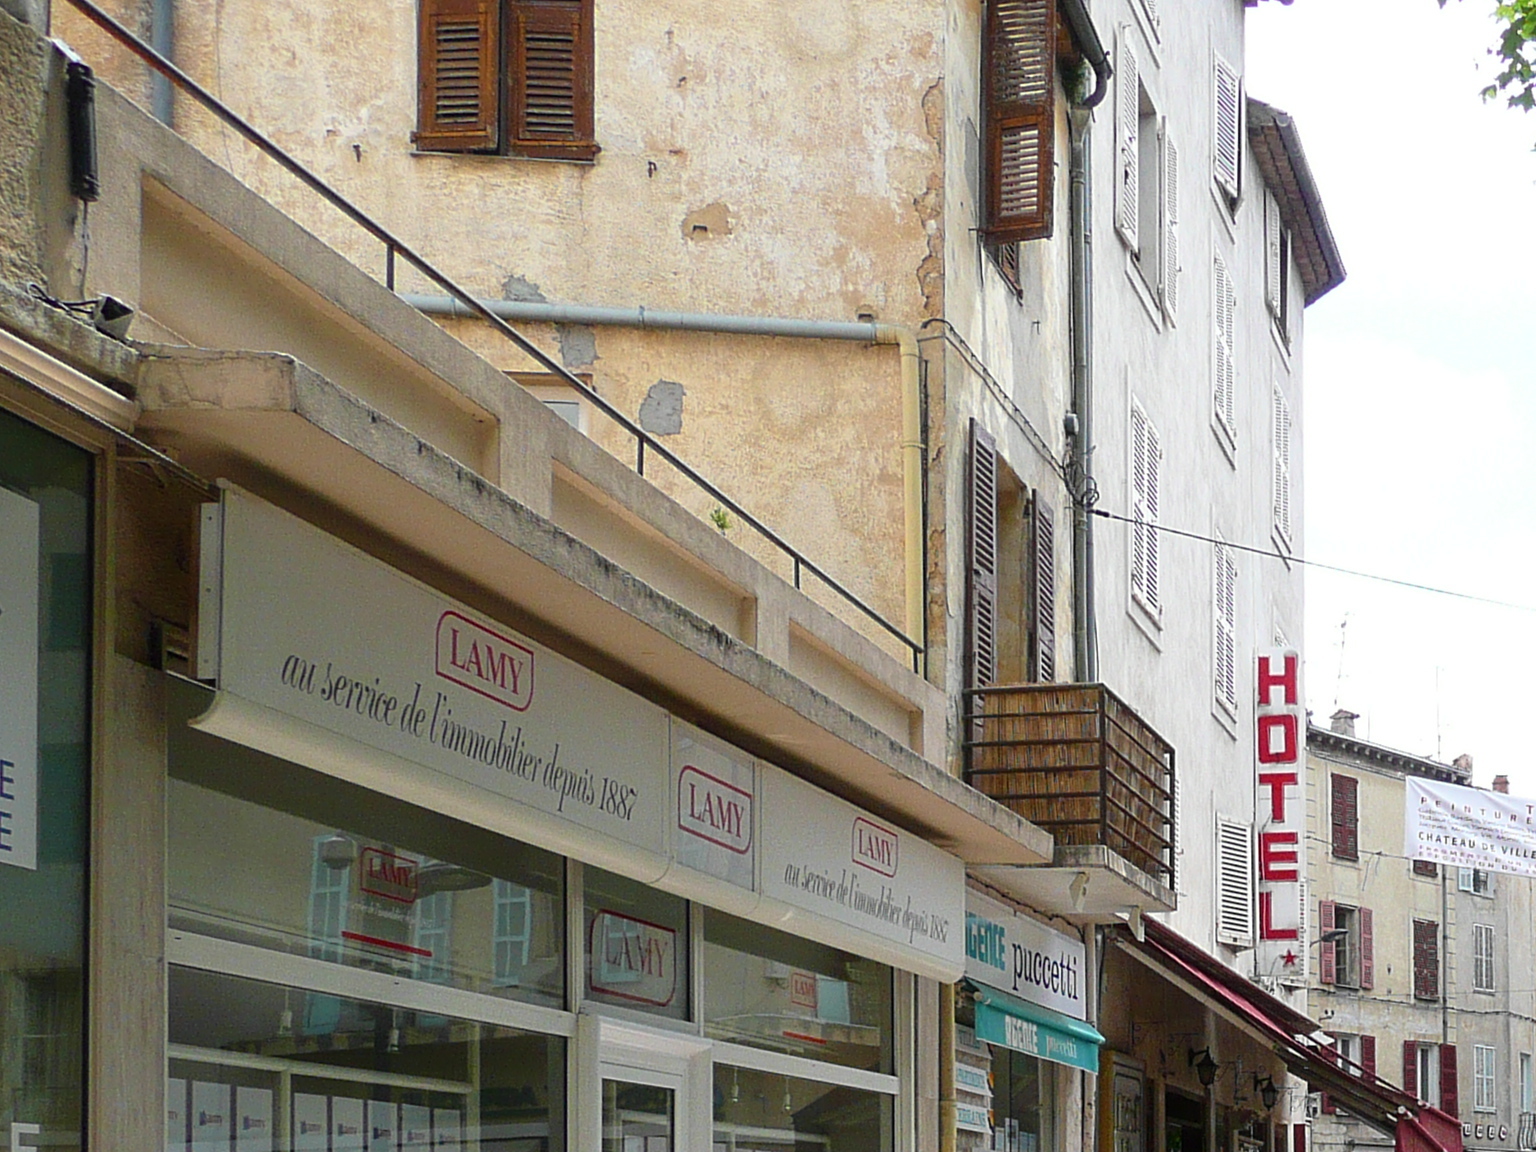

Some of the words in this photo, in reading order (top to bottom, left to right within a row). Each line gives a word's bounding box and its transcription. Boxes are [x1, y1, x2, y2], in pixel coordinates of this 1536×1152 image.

[450, 627, 524, 696] LAMY
[281, 654, 317, 695] au
[320, 662, 398, 726] service
[400, 682, 426, 738] de
[429, 692, 542, 782] l'immobilier
[543, 743, 595, 813] depuis
[600, 776, 639, 821] 1887
[689, 783, 745, 838] LAMY
[1257, 655, 1299, 941] HOTEL
[1420, 796, 1532, 825] PEINTURE
[859, 829, 893, 867] LAMY
[1418, 831, 1476, 849] CHATEAU
[1481, 843, 1496, 854] DE
[367, 857, 411, 888] LAMY
[801, 864, 836, 901] service
[836, 869, 848, 905] de
[902, 896, 929, 944] depuis
[603, 922, 670, 978] LAMY
[1012, 942, 1078, 1001] puccetti
[1005, 1014, 1039, 1054] AGENCE
[1045, 1035, 1078, 1059] puccetti
